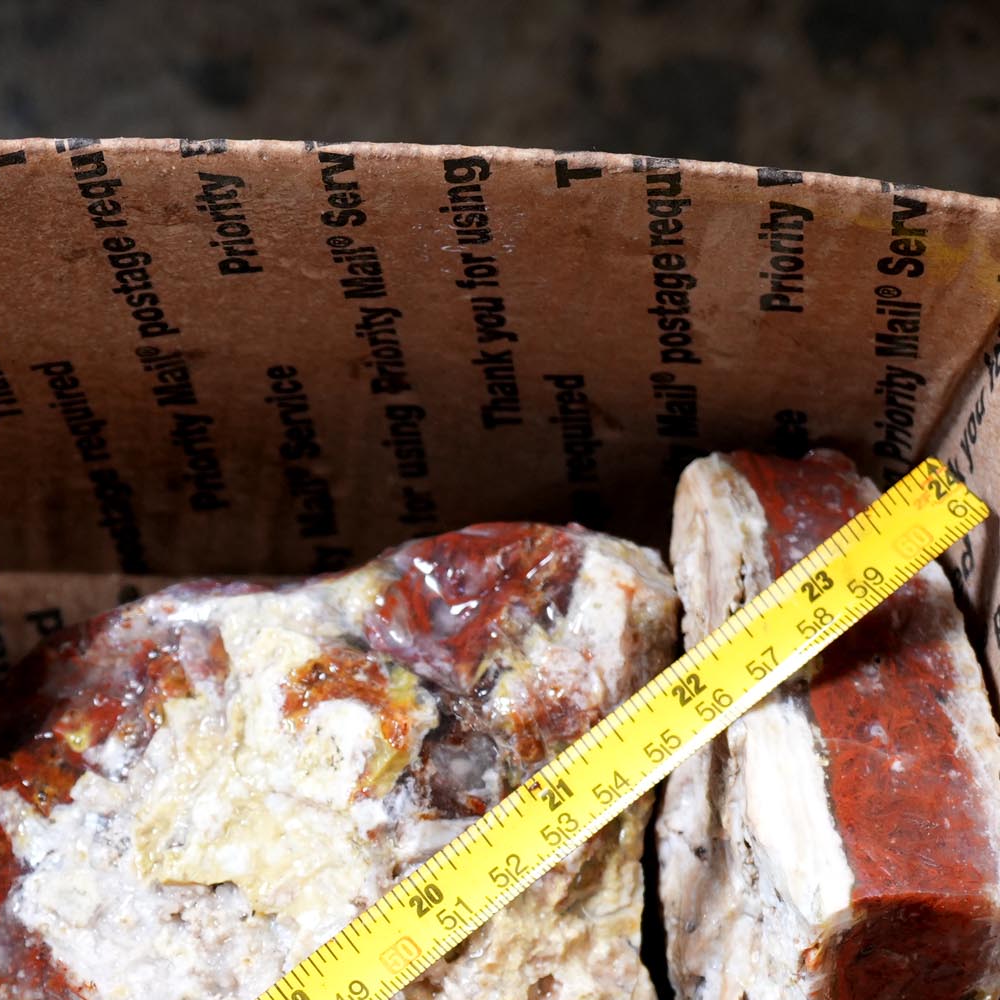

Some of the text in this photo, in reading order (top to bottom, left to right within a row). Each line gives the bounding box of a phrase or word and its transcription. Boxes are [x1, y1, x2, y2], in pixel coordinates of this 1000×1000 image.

[194, 171, 263, 276] Priority
[758, 200, 814, 313] Priority
[103, 235, 181, 340] postage
[439, 155, 523, 430] Thank you for using
[648, 252, 702, 364] postage
[355, 306, 412, 395] Priority
[29, 360, 113, 463] required
[168, 412, 232, 513] Priority
[381, 404, 429, 478] using
[872, 365, 927, 465] Priority
[409, 883, 444, 918] 20
[541, 778, 574, 811] 21
[671, 673, 707, 707] 22
[801, 570, 834, 603] 23
[436, 896, 473, 931] 51
[488, 853, 529, 888] 52
[540, 812, 579, 847] 53
[592, 770, 630, 805] 54
[643, 729, 681, 763] 55
[695, 688, 733, 722] 56
[745, 645, 779, 681] 57
[796, 607, 834, 640] 58
[847, 567, 884, 599] 59
